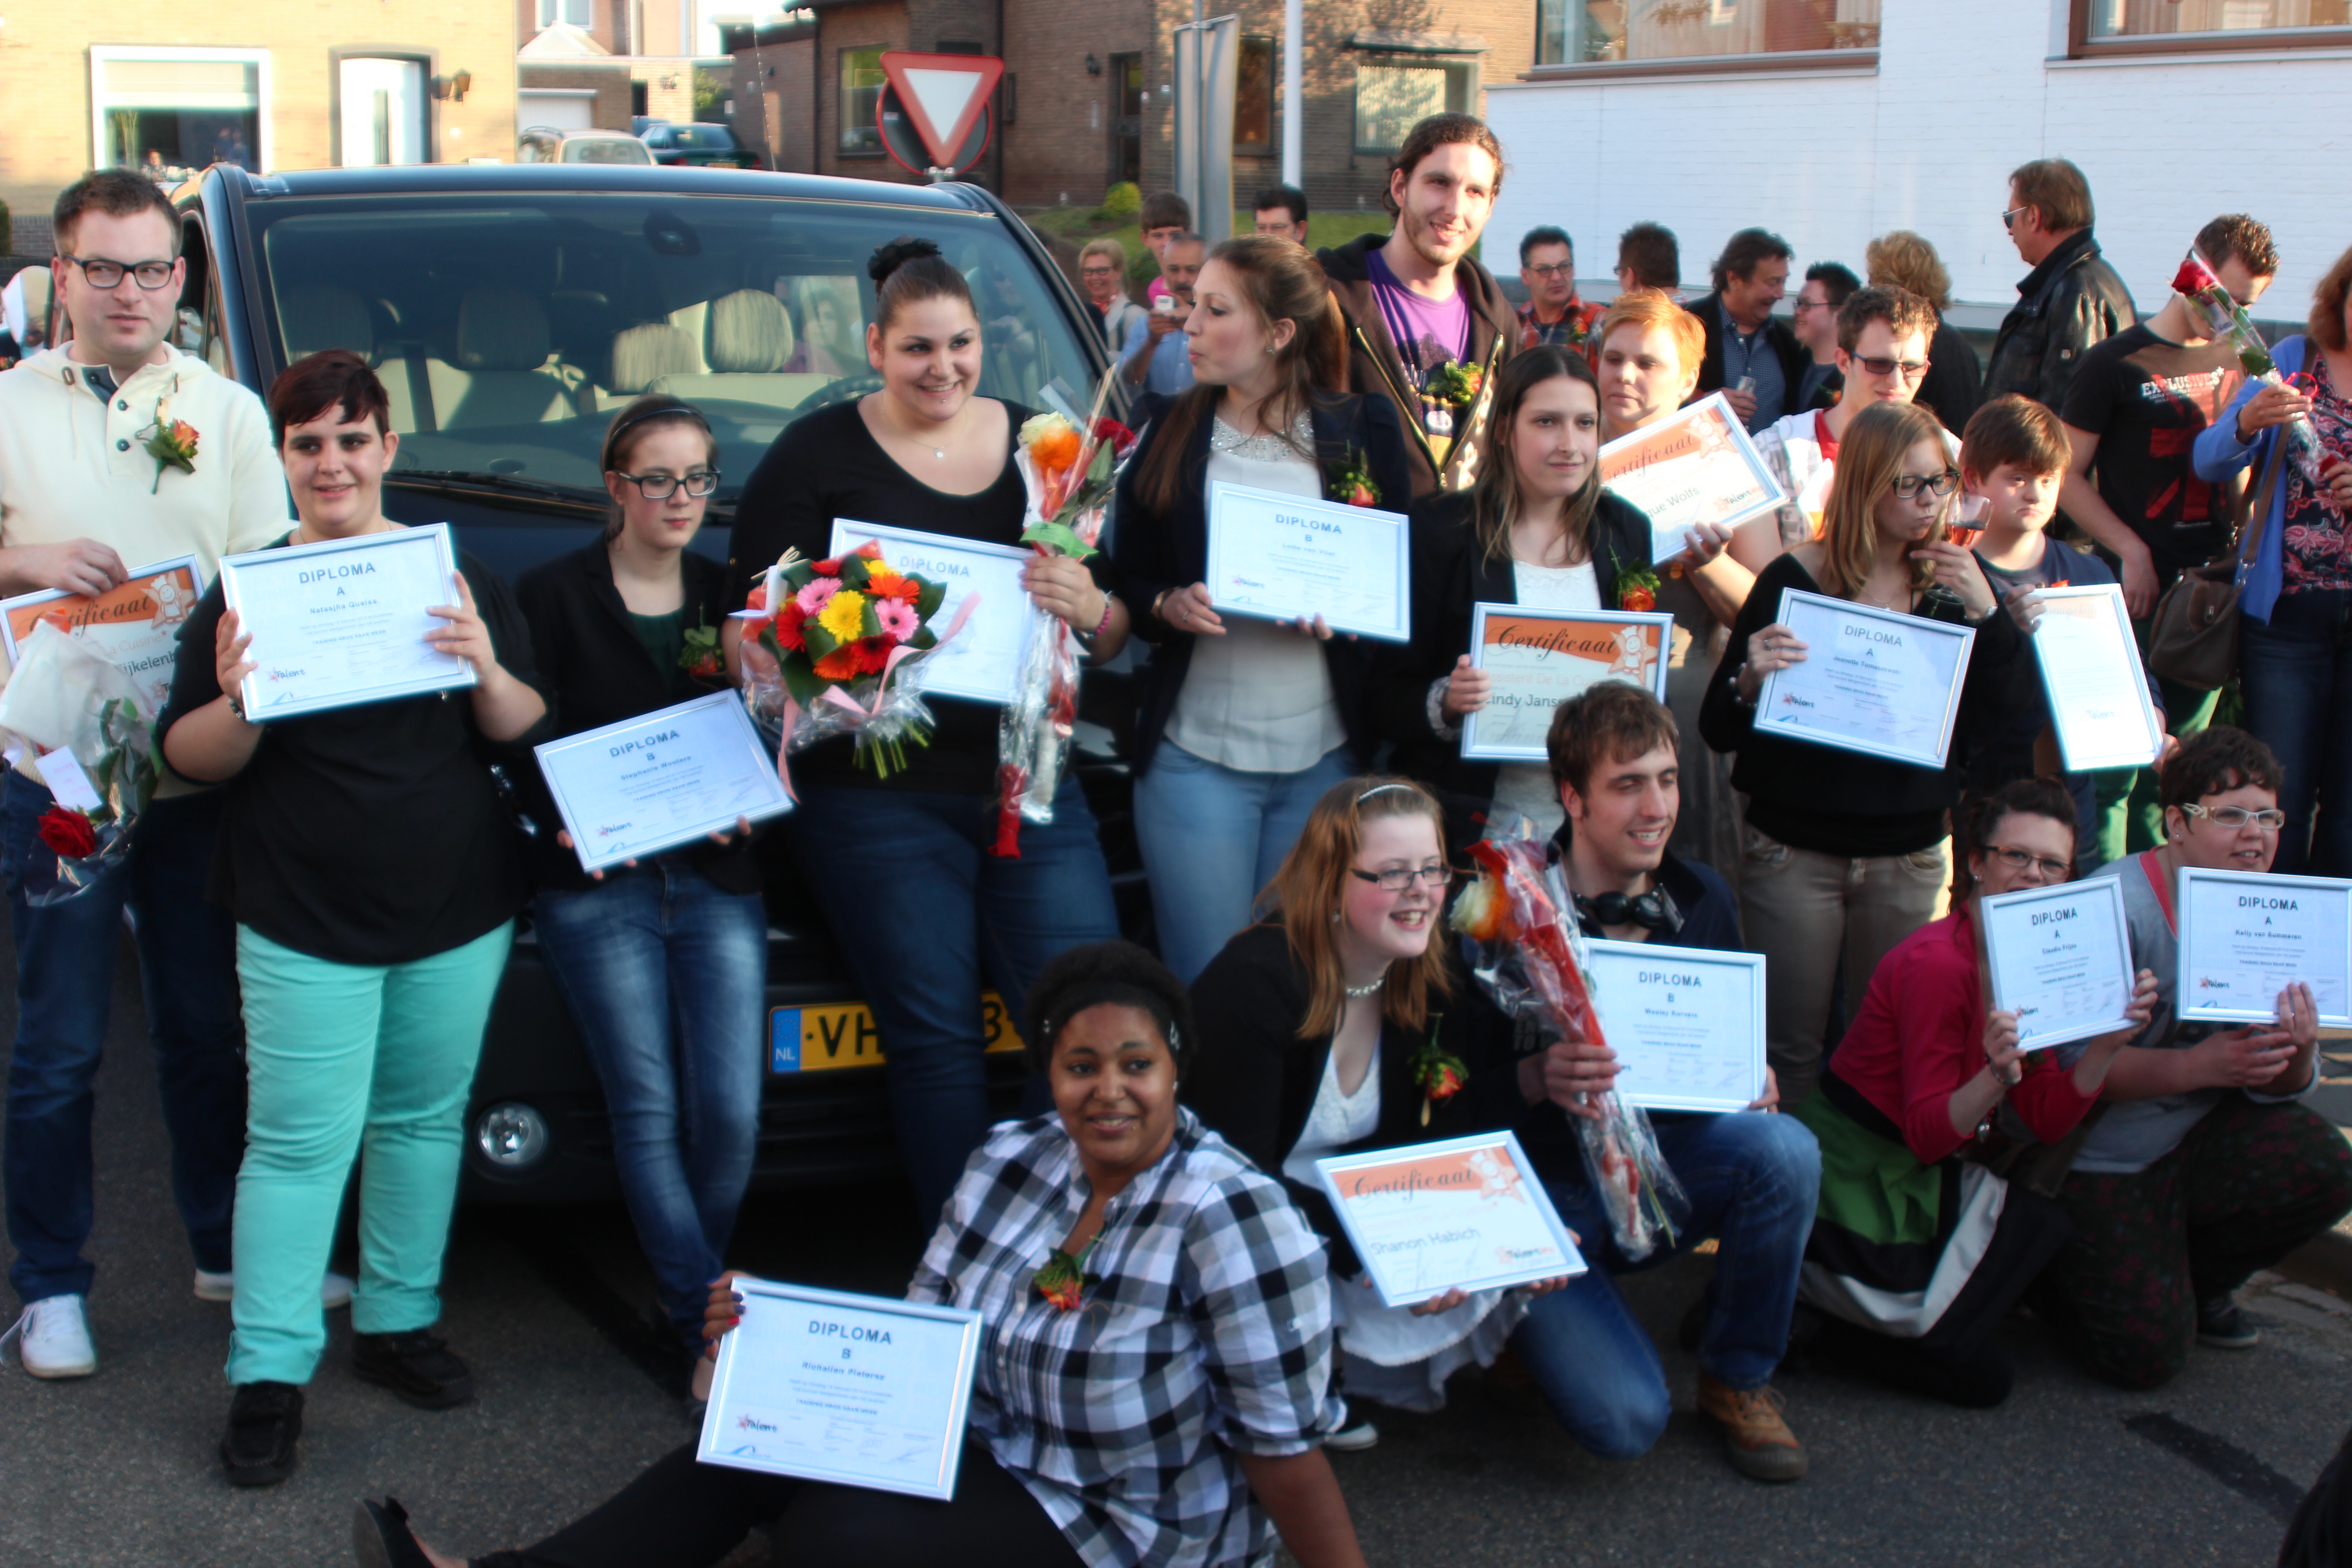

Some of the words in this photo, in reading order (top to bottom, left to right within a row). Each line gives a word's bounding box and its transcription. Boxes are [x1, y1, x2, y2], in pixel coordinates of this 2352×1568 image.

[1667, 485, 1700, 507] Wolfs
[1275, 514, 1342, 534] DIPLOMA
[1305, 534, 1312, 542] B
[299, 561, 376, 584] DIPLOMA
[900, 556, 970, 577] DIPLOMA
[336, 586, 345, 596] A
[309, 602, 346, 615] Natasjha
[1491, 625, 1619, 661] Certificaat
[1844, 624, 1903, 647] DIPLOMA
[1866, 647, 1874, 657] A
[275, 668, 306, 679] Talent
[608, 729, 680, 758] DIPLOMA
[646, 752, 655, 762] B
[2239, 895, 2299, 911] DIPLOMA
[2032, 906, 2078, 926] DIPLOMA
[2265, 915, 2273, 925] A
[2055, 928, 2061, 939] A
[1639, 971, 1702, 988] DIPLOMA
[1668, 992, 1675, 1003] B
[775, 1047, 796, 1061] NL
[1349, 1168, 1473, 1205] Certificaat
[1370, 1237, 1428, 1255] Shanon
[808, 1320, 892, 1345] DIPLOMA
[842, 1348, 851, 1359] B
[747, 1418, 777, 1433] Talent
